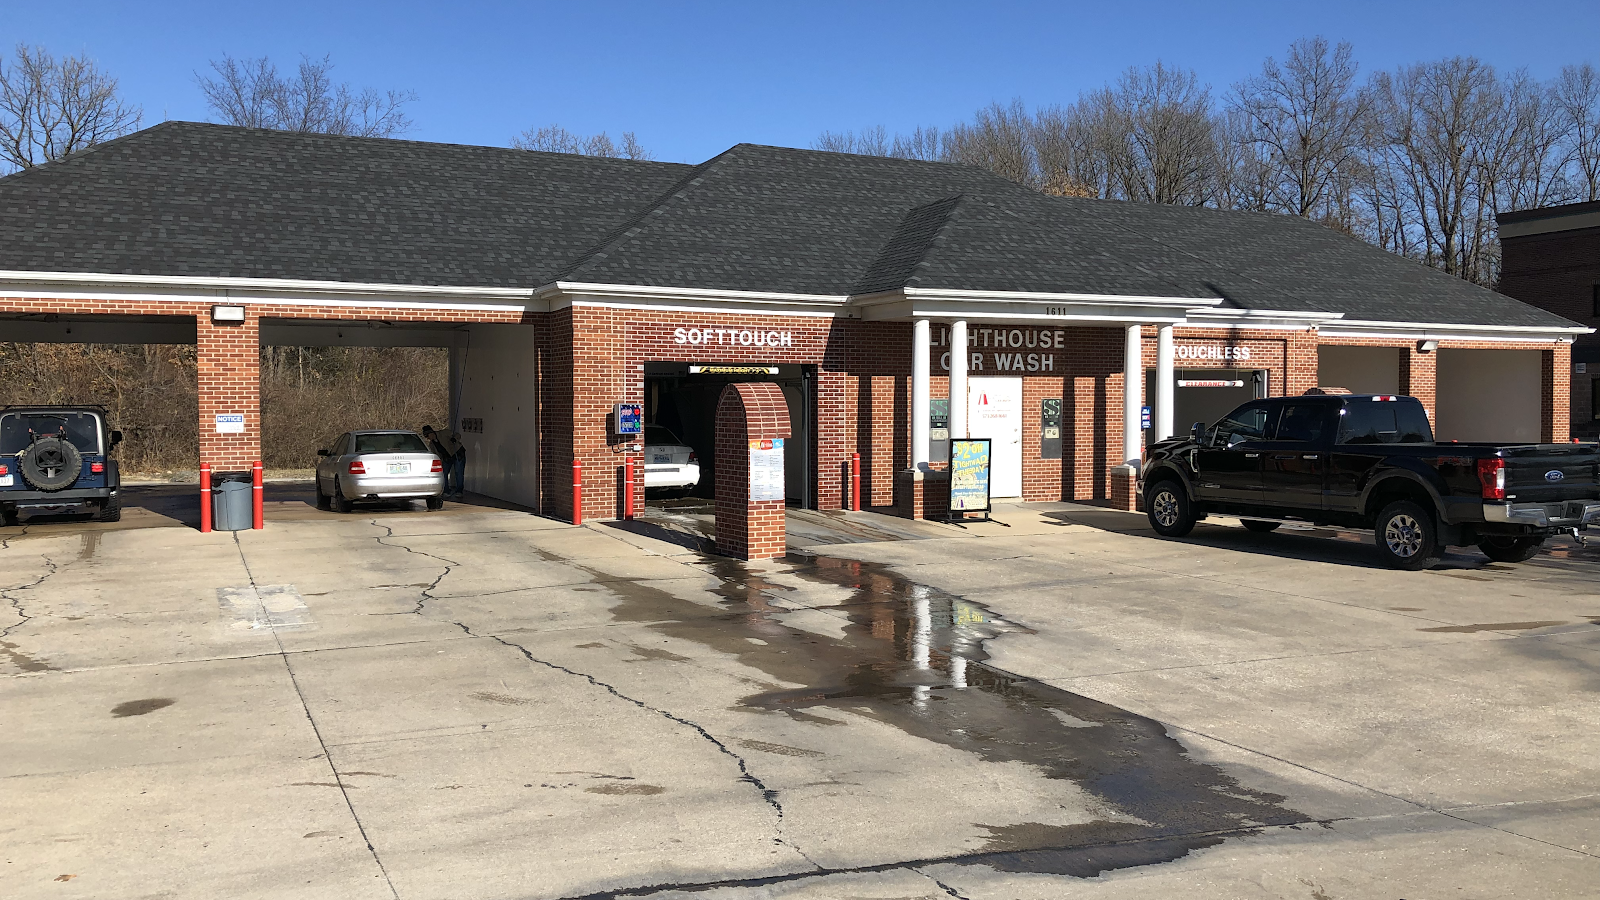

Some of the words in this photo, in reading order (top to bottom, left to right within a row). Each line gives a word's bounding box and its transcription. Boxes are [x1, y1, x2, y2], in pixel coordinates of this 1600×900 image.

[1045, 307, 1067, 316] 1611
[674, 327, 792, 348] SOFTTOUCH
[929, 328, 1065, 349] LIHTHOUSE
[940, 351, 984, 371] CR
[994, 353, 1054, 372] WASH
[957, 441, 971, 459] $2
[952, 454, 988, 469] TIGHTWAD
